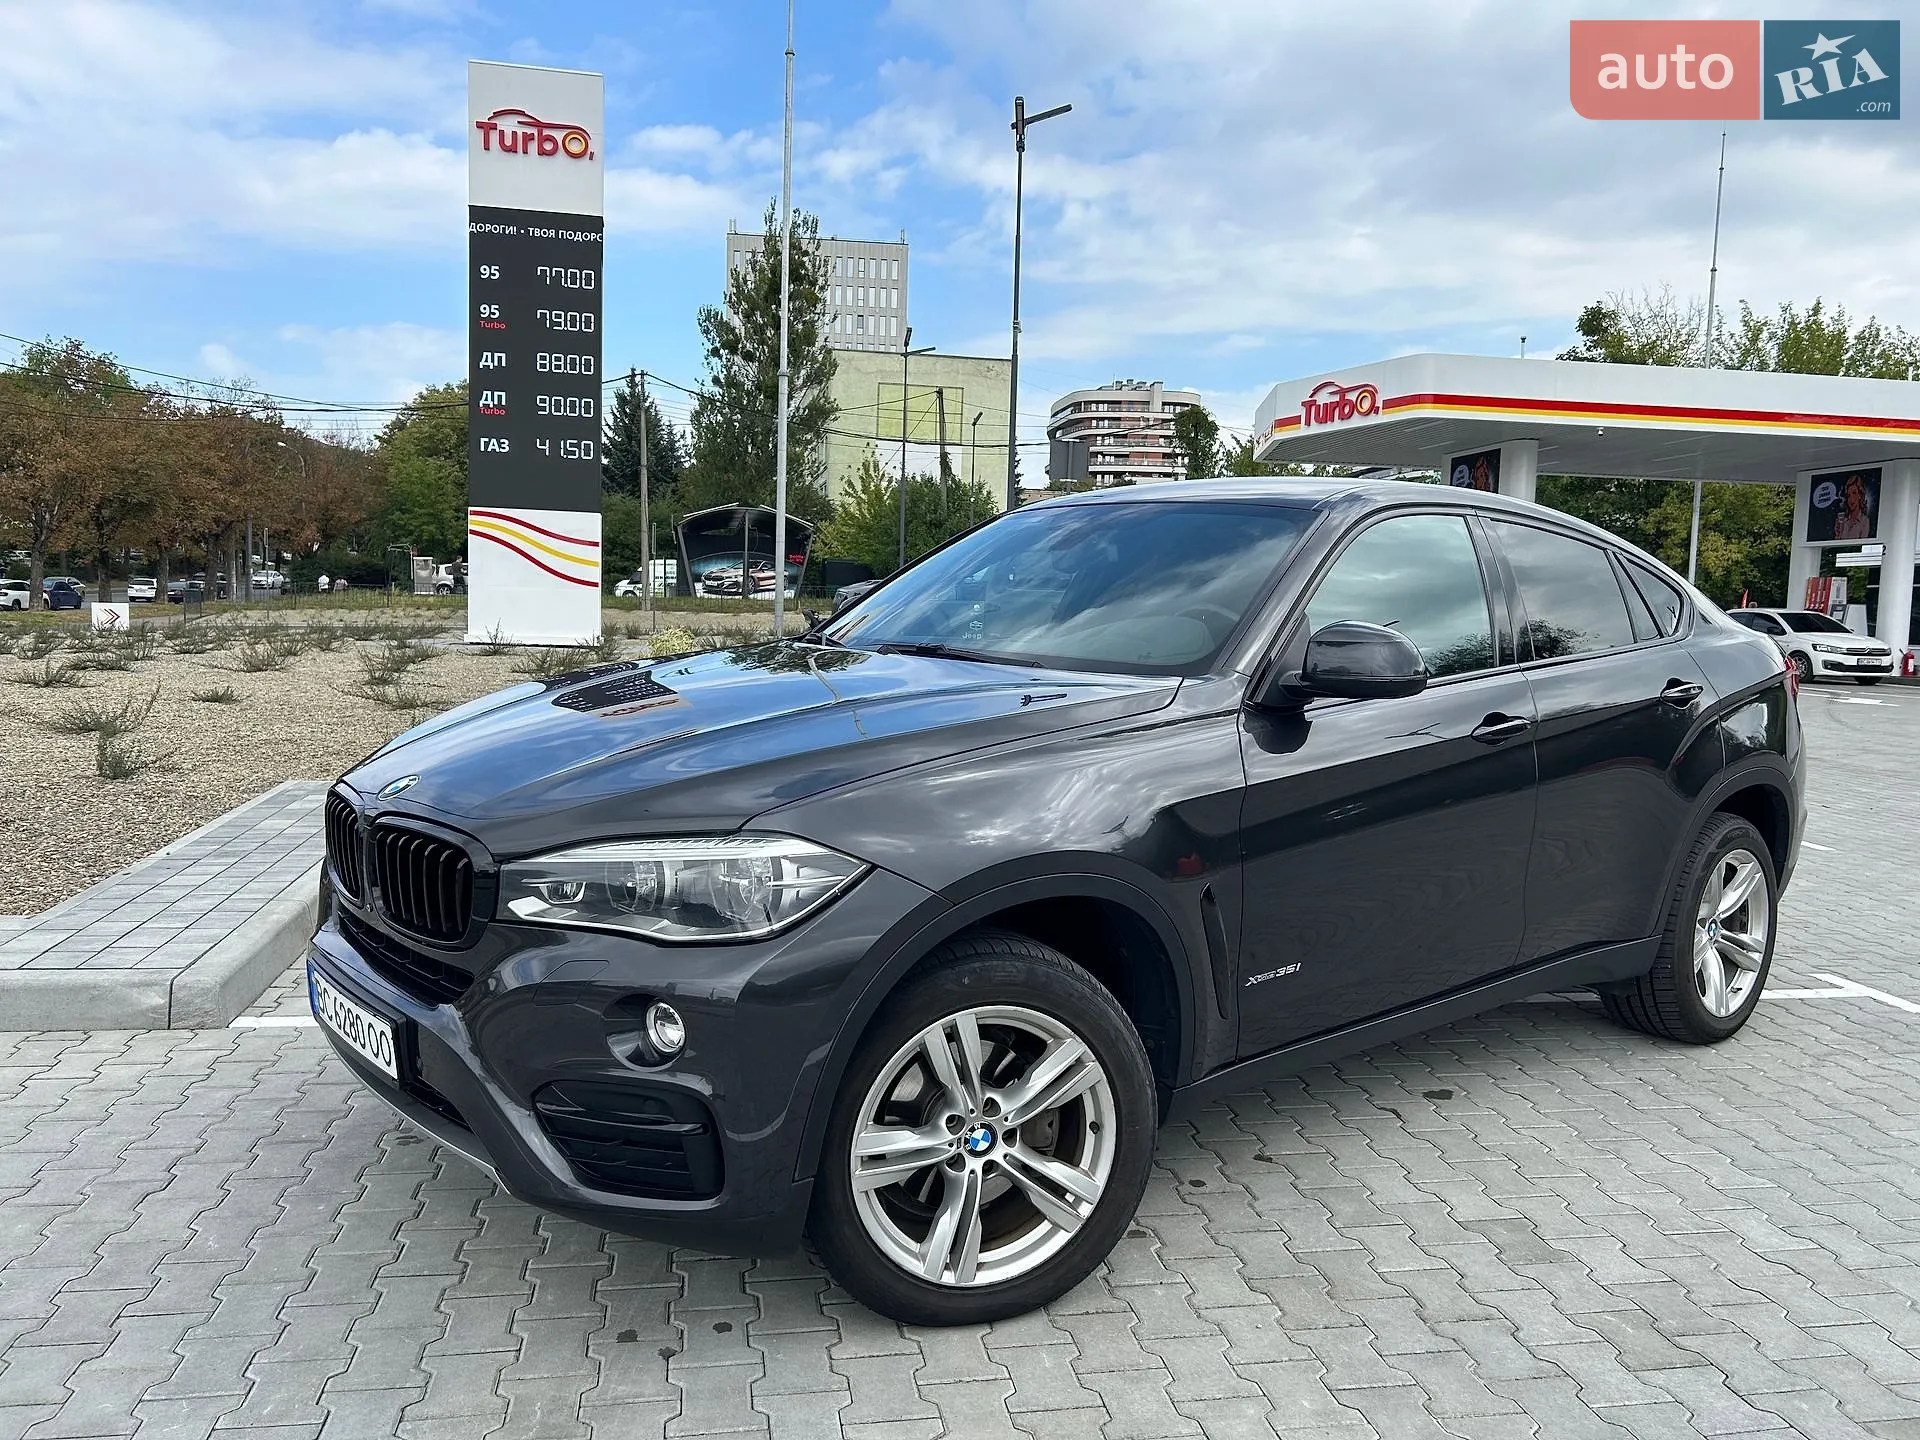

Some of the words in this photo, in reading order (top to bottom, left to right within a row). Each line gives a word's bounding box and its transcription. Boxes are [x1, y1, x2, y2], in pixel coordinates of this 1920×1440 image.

[469, 222, 517, 235] ДОРОГИ!
[528, 227, 555, 239] ТВОЯ
[479, 265, 500, 280] 95
[536, 266, 595, 290] 77.00
[479, 304, 500, 319] 95
[536, 309, 595, 333] 79.00
[479, 321, 506, 330] Turbo
[479, 351, 506, 369] ДП
[536, 352, 594, 375] 88.00
[479, 390, 506, 408] ДП
[536, 395, 594, 418] 90.00
[479, 407, 506, 415] Turbo
[480, 438, 510, 453] ГАЗ
[333, 996, 366, 1050] 6280
